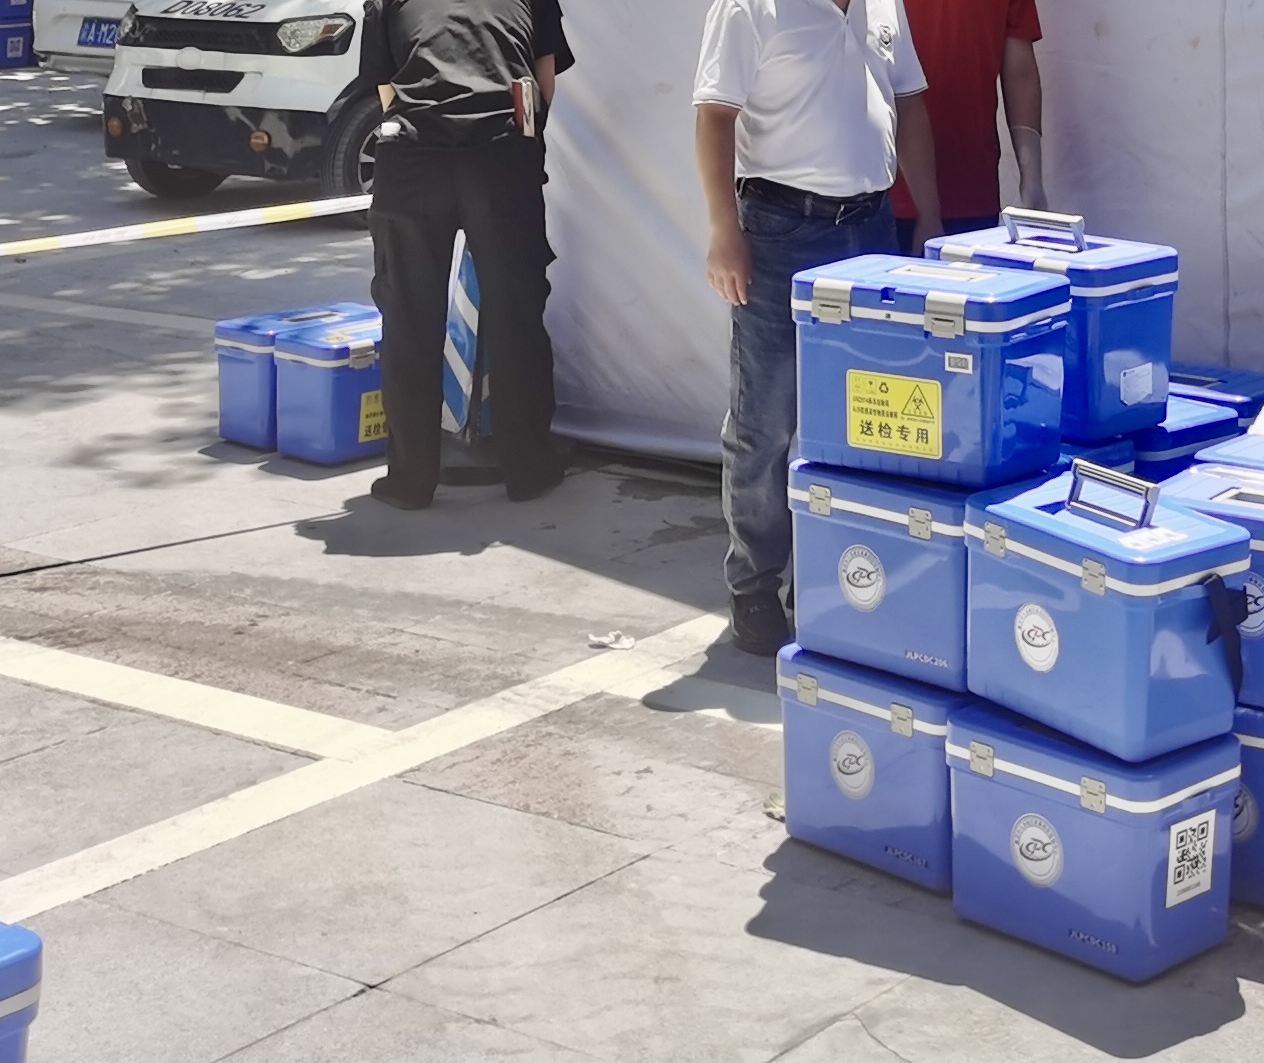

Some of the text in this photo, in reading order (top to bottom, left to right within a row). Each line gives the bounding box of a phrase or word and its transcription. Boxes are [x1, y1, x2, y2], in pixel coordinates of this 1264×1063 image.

[160, 0, 267, 19] D08062
[859, 418, 929, 445] 送检专用
